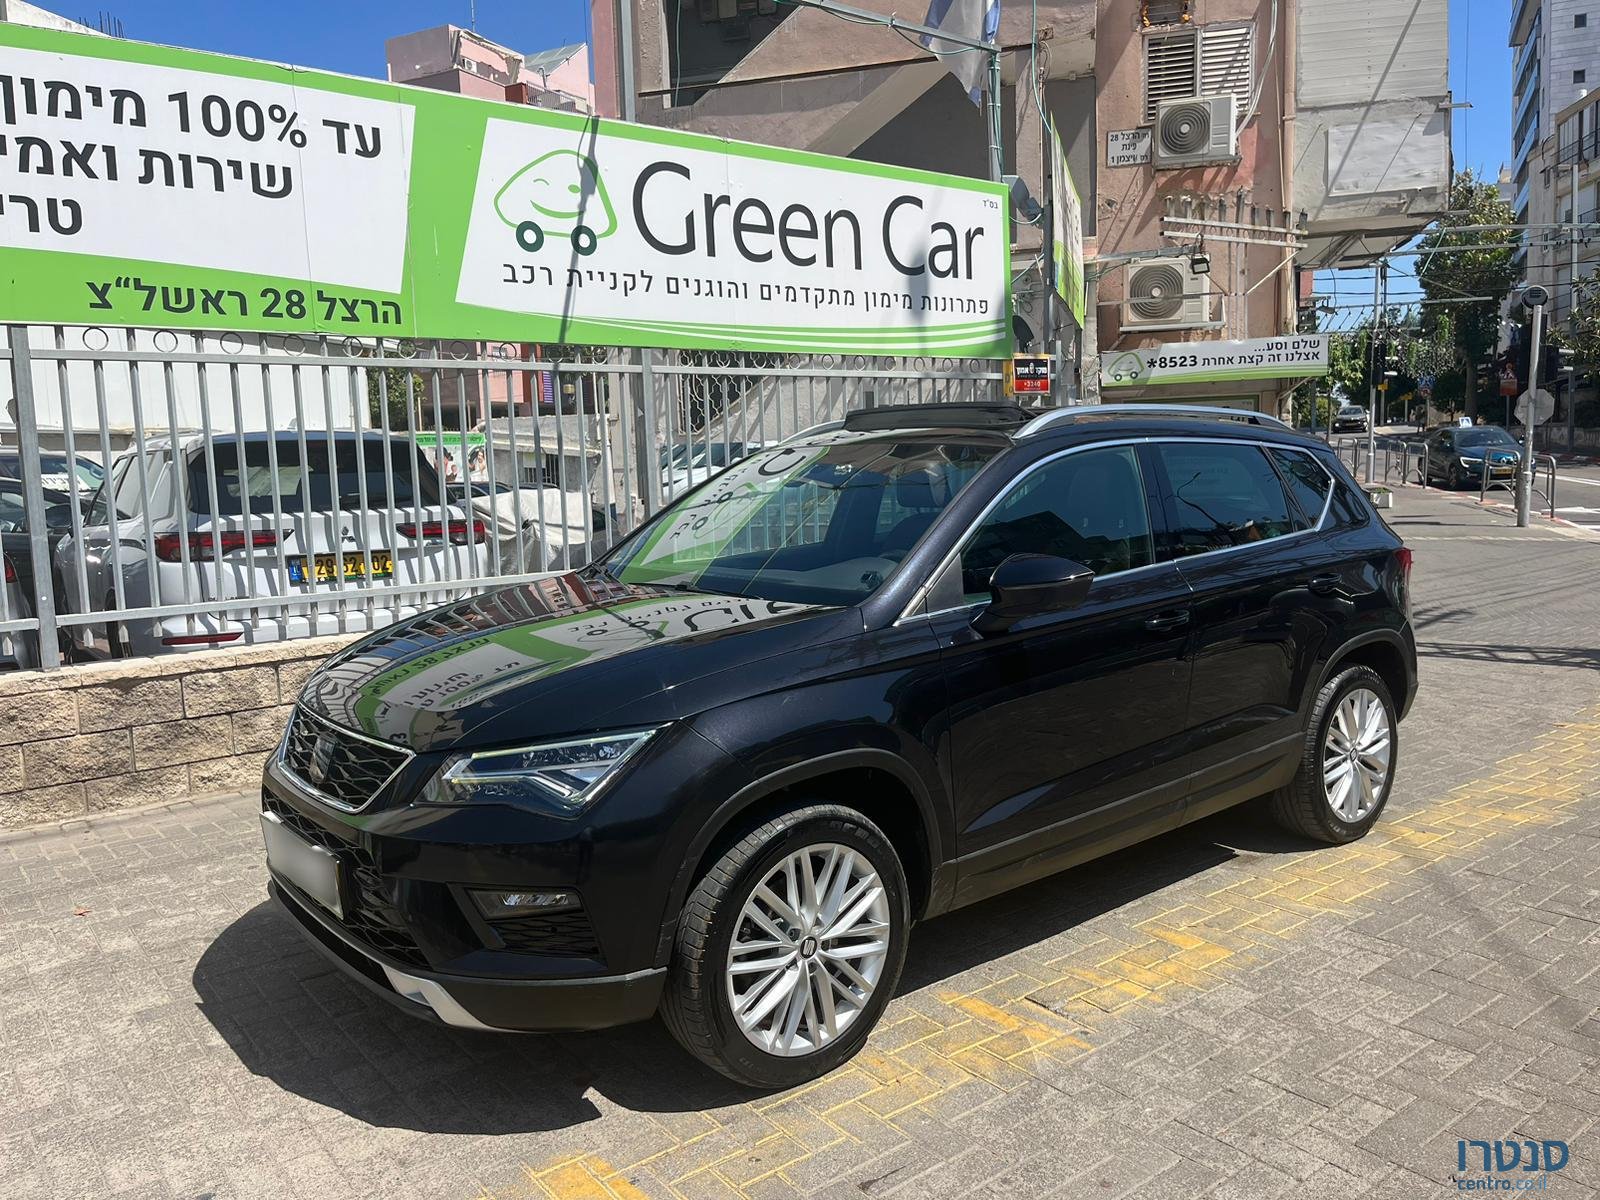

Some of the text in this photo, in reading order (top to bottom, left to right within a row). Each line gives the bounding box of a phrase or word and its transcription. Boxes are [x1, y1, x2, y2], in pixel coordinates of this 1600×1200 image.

[168, 92, 307, 148] 100%
[323, 120, 381, 159] עד
[1110, 134, 1119, 142] 28
[1120, 132, 1140, 141] הרצל
[1121, 142, 1137, 151] פינת
[139, 149, 292, 198] שירות
[633, 162, 861, 271] Green
[883, 196, 984, 284] Car
[503, 264, 988, 315] פתרונות מימון מתקדמים והוגנים לקניית רכב
[261, 288, 307, 319] 28
[317, 290, 402, 325] הרצל
[1292, 339, 1320, 350] שלם
[1202, 356, 1235, 367] אחרת
[1238, 354, 1263, 367] קצת
[1267, 352, 1281, 363] זה
[1285, 350, 1320, 362] אצלנו
